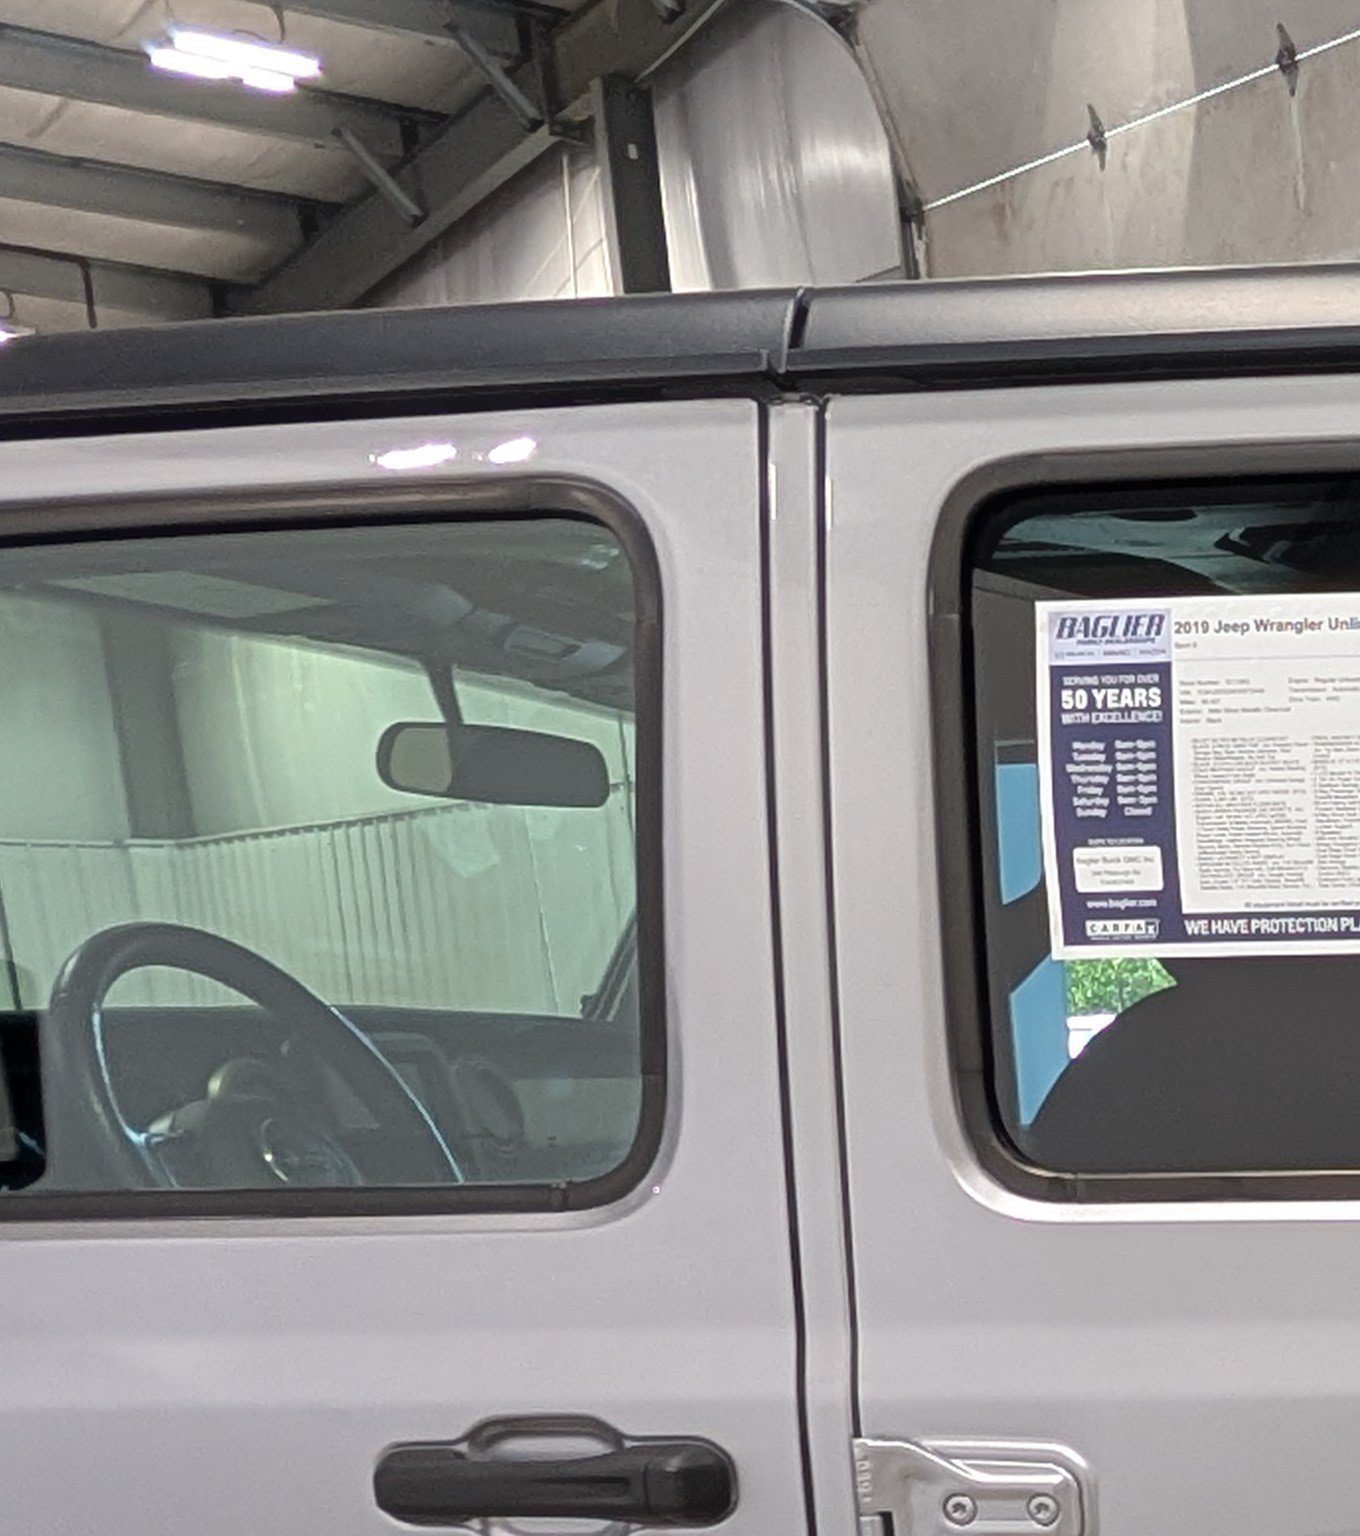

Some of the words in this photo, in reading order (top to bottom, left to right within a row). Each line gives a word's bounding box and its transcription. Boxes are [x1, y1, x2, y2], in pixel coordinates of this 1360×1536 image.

[1056, 613, 1166, 640] BAGLIER
[1174, 620, 1210, 634] 2019
[1214, 619, 1250, 636] Jeep
[1253, 617, 1324, 636] Wrangler
[1061, 688, 1088, 710] 50
[1091, 687, 1162, 709] YEARS
[1184, 919, 1209, 935] WE
[1211, 919, 1250, 934] HAVE
[1251, 917, 1339, 934] PROTECTION
